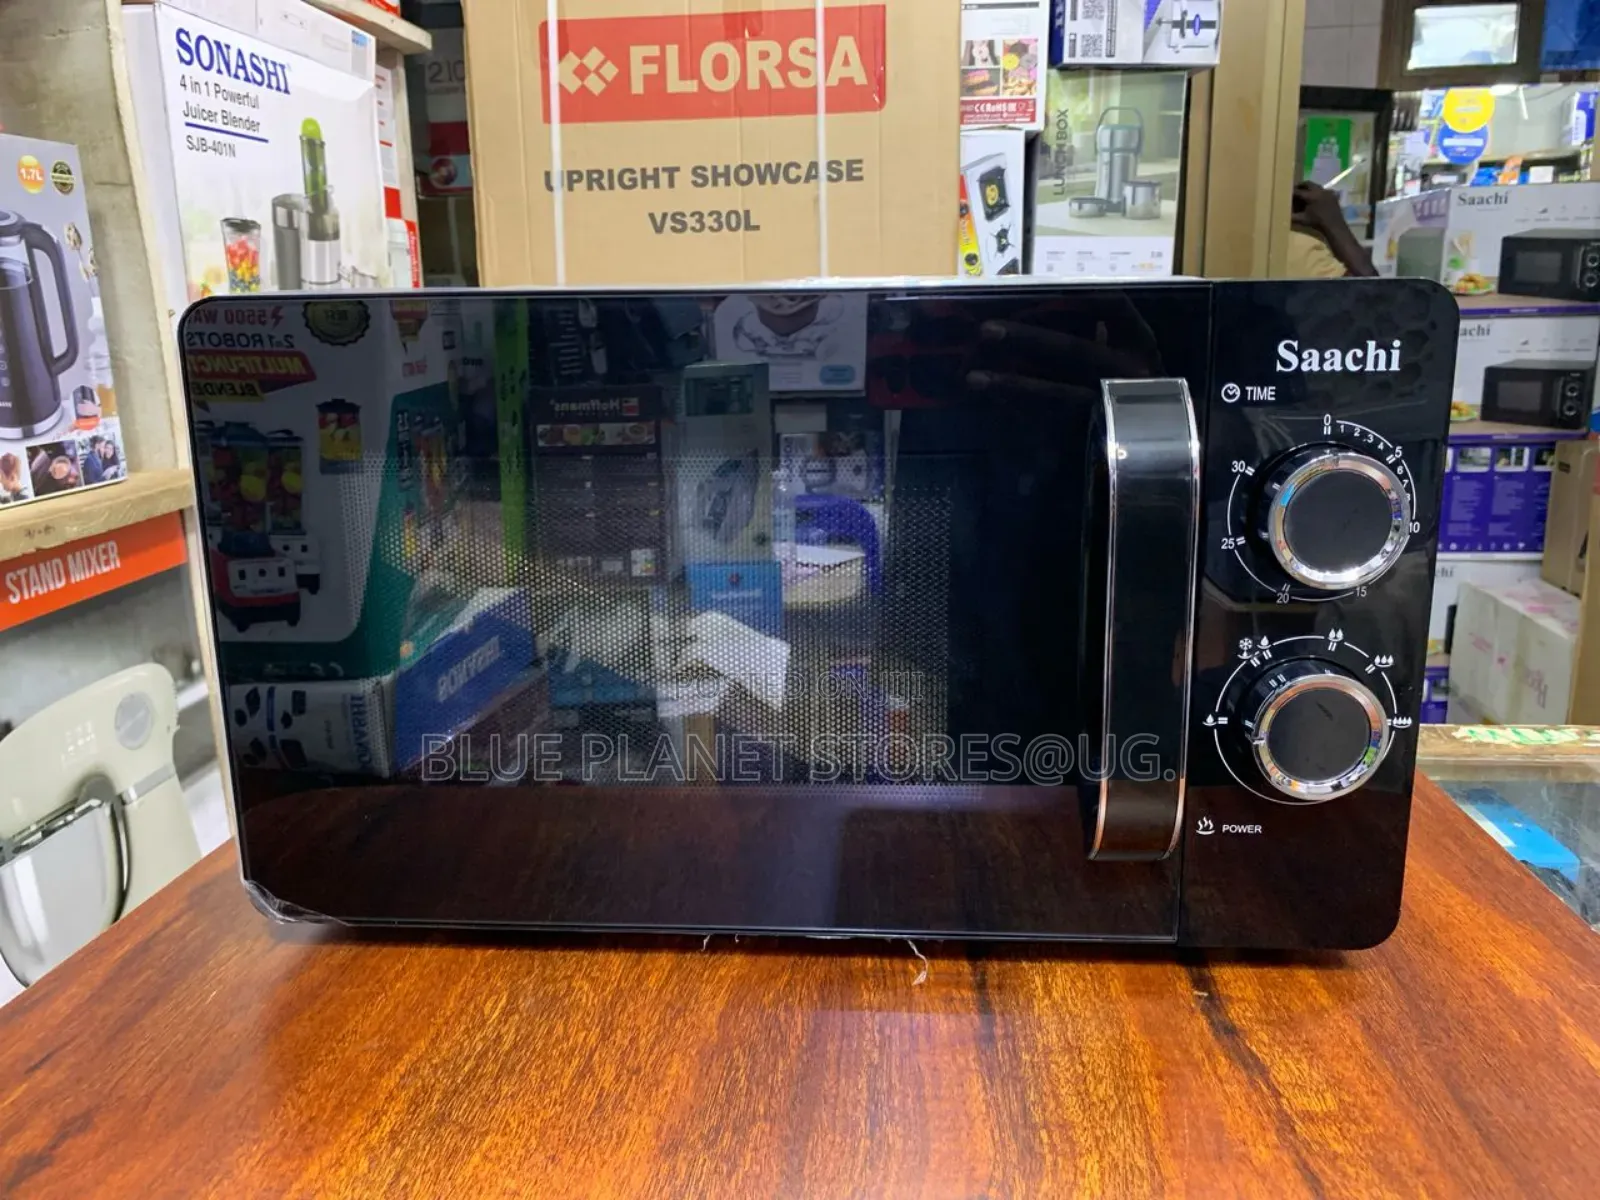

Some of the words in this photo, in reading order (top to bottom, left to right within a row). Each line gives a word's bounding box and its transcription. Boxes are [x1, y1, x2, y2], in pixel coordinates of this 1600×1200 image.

[175, 27, 291, 95] SONASHI
[629, 35, 868, 95] FLORSA
[180, 73, 187, 91] 4
[189, 75, 202, 95] in
[204, 80, 210, 97] 1
[213, 82, 260, 110] Powerful
[183, 100, 218, 124] Juicer
[220, 108, 261, 133] Blender
[1056, 108, 1069, 141] BOX
[186, 134, 237, 158] SJB-401N
[544, 166, 681, 192] UPRIGHT
[690, 159, 864, 188] SHOWCASE
[1053, 142, 1067, 196] LUNCH
[1457, 190, 1509, 207] Saachi
[648, 210, 761, 235] VS330L
[1459, 323, 1491, 337] achi
[1276, 339, 1401, 373] Saachi
[1245, 386, 1276, 401] TIME
[1323, 413, 1331, 426] 0
[1353, 427, 1361, 436] 2
[1366, 434, 1374, 443] 3
[1377, 442, 1384, 450] 4
[1394, 446, 1403, 458] 5
[1231, 460, 1246, 474] 30
[1396, 465, 1404, 475] 6
[1409, 521, 1420, 533] 10
[1221, 538, 1235, 550] 25
[5, 557, 66, 604] STAND
[66, 540, 121, 584] MIXER
[1276, 592, 1290, 605] 20
[1355, 585, 1367, 597] 15
[1222, 824, 1262, 834] POWER
